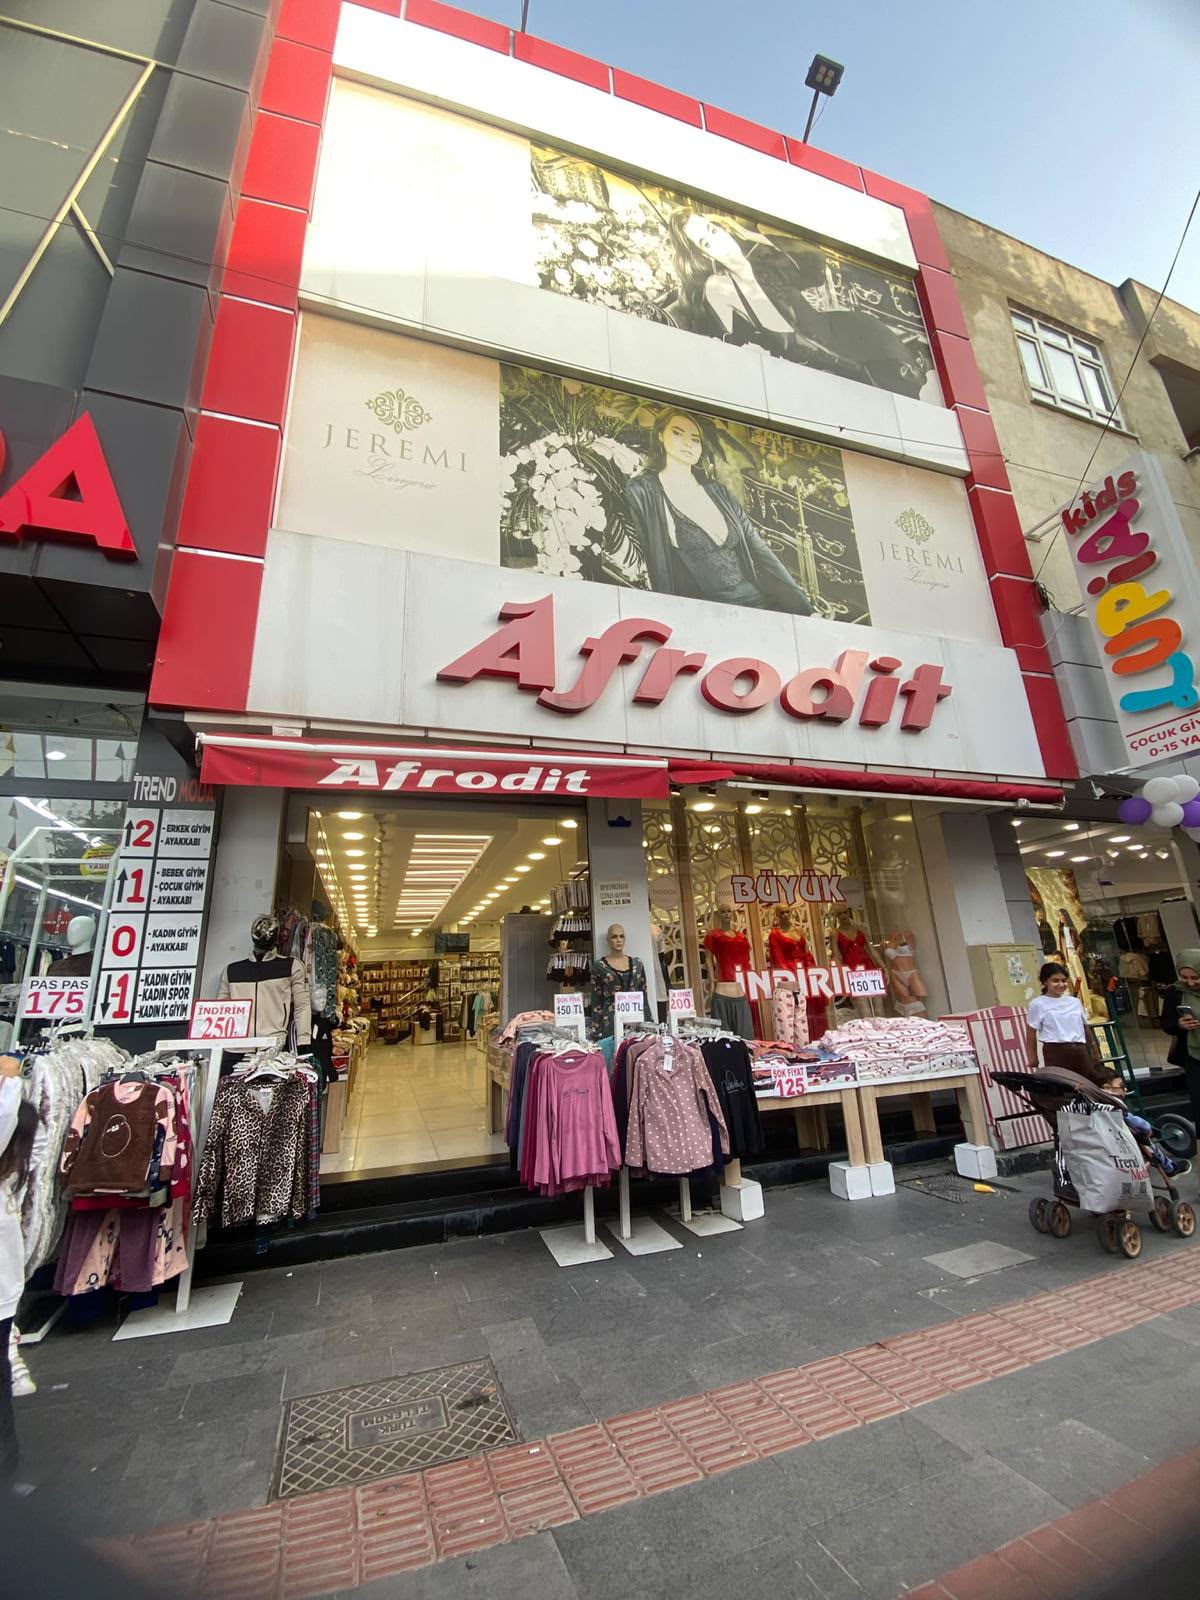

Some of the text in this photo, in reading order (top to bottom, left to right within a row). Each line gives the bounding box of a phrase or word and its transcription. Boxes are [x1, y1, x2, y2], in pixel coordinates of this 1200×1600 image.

[322, 423, 468, 473] JEREMI
[1061, 470, 1139, 536] kids
[879, 541, 964, 574] JEREMI
[435, 593, 952, 732] Afrodit
[1130, 727, 1177, 752] ÇOCUK
[1149, 741, 1178, 757] 0-15
[317, 758, 592, 794] Afrodit
[133, 775, 177, 802] TREND
[132, 819, 155, 848] 2
[166, 823, 211, 834] ERKEK GİYİM
[164, 837, 201, 847] AYAKKABI
[161, 866, 206, 878] BEBEK GİYİM
[126, 868, 145, 904] 1
[158, 879, 204, 893] ÇOCUK GİYİM
[731, 868, 848, 906] BÜYÜK
[156, 895, 192, 905] AYAKKABI
[111, 925, 137, 958] 0
[152, 927, 198, 939] KADIN GİYİM
[150, 942, 188, 953] AYAKKABI
[30, 980, 89, 990] PAS PAS
[170, 971, 192, 986] GİYİM
[851, 979, 886, 992] 150 TL
[169, 987, 190, 1000] SPOR
[24, 991, 84, 1014] 175
[169, 1000, 188, 1017] GİYİM
[198, 1004, 246, 1016] İNDİRİM
[671, 998, 691, 1010] 200
[201, 1016, 236, 1039] 250
[776, 1077, 805, 1097] 125
[1108, 1155, 1139, 1169] Trend
[361, 1404, 431, 1429] TELEKOM
